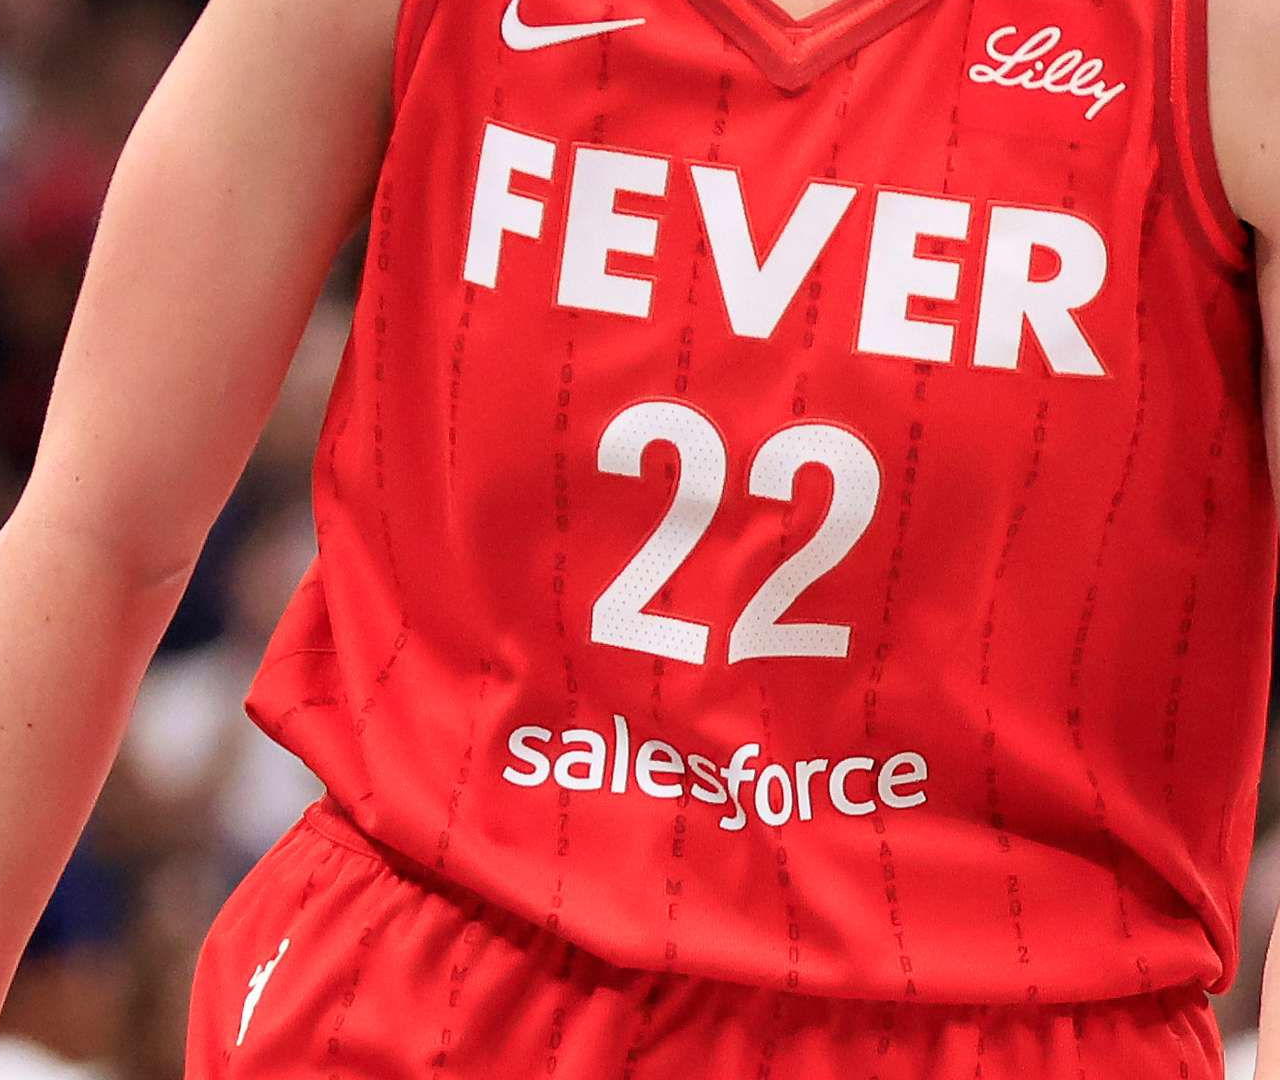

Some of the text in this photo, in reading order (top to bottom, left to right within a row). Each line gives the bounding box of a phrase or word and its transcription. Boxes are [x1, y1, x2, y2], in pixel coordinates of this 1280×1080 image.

[970, 27, 1125, 119] Lilly
[464, 122, 1107, 375] FEVER
[591, 402, 879, 664] 22
[503, 715, 927, 830] salesforce
